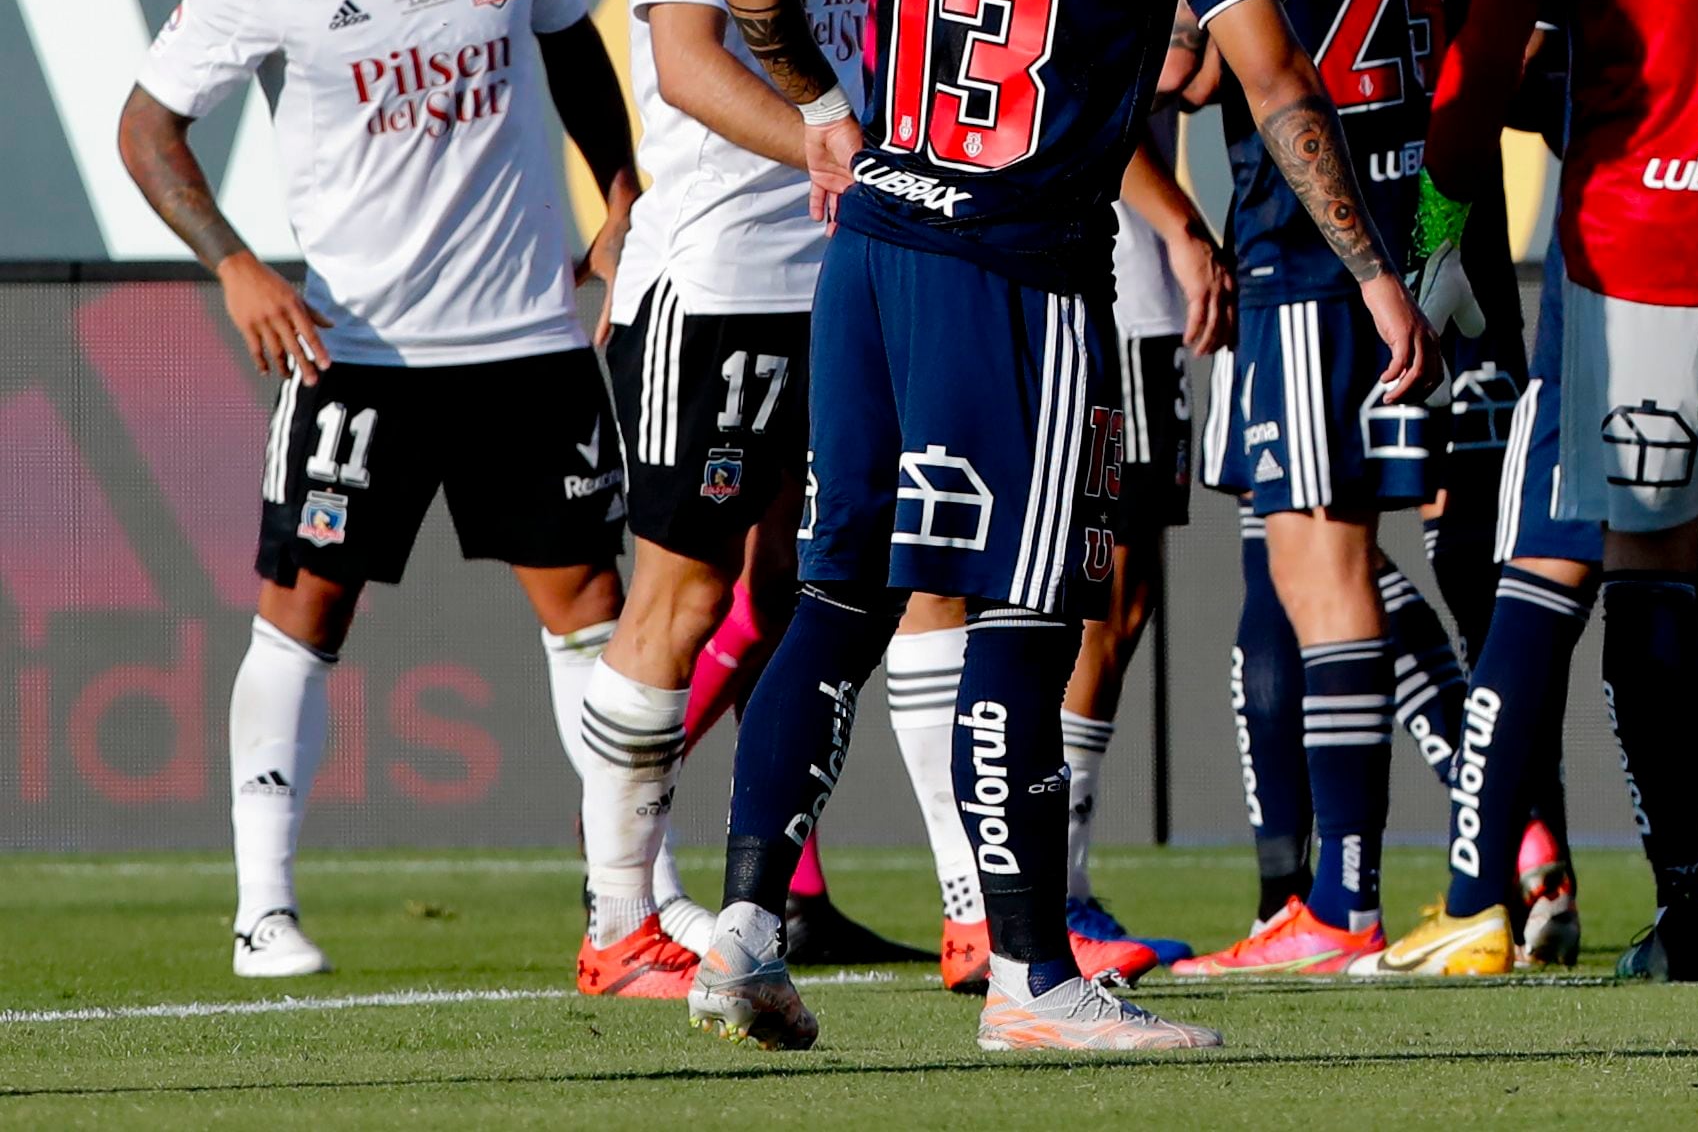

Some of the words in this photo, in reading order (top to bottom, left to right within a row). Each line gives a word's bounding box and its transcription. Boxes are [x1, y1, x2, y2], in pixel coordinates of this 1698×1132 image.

[329, 12, 371, 31] adidas
[349, 36, 512, 104] Pilsen
[366, 105, 418, 137] del
[425, 79, 508, 138] Sur
[853, 157, 973, 218] LUBRAX
[716, 349, 789, 434] 17
[306, 401, 379, 490] 11
[1083, 527, 1115, 582] U
[958, 700, 1022, 875] Dolorub
[1448, 685, 1502, 879] Dolorub
